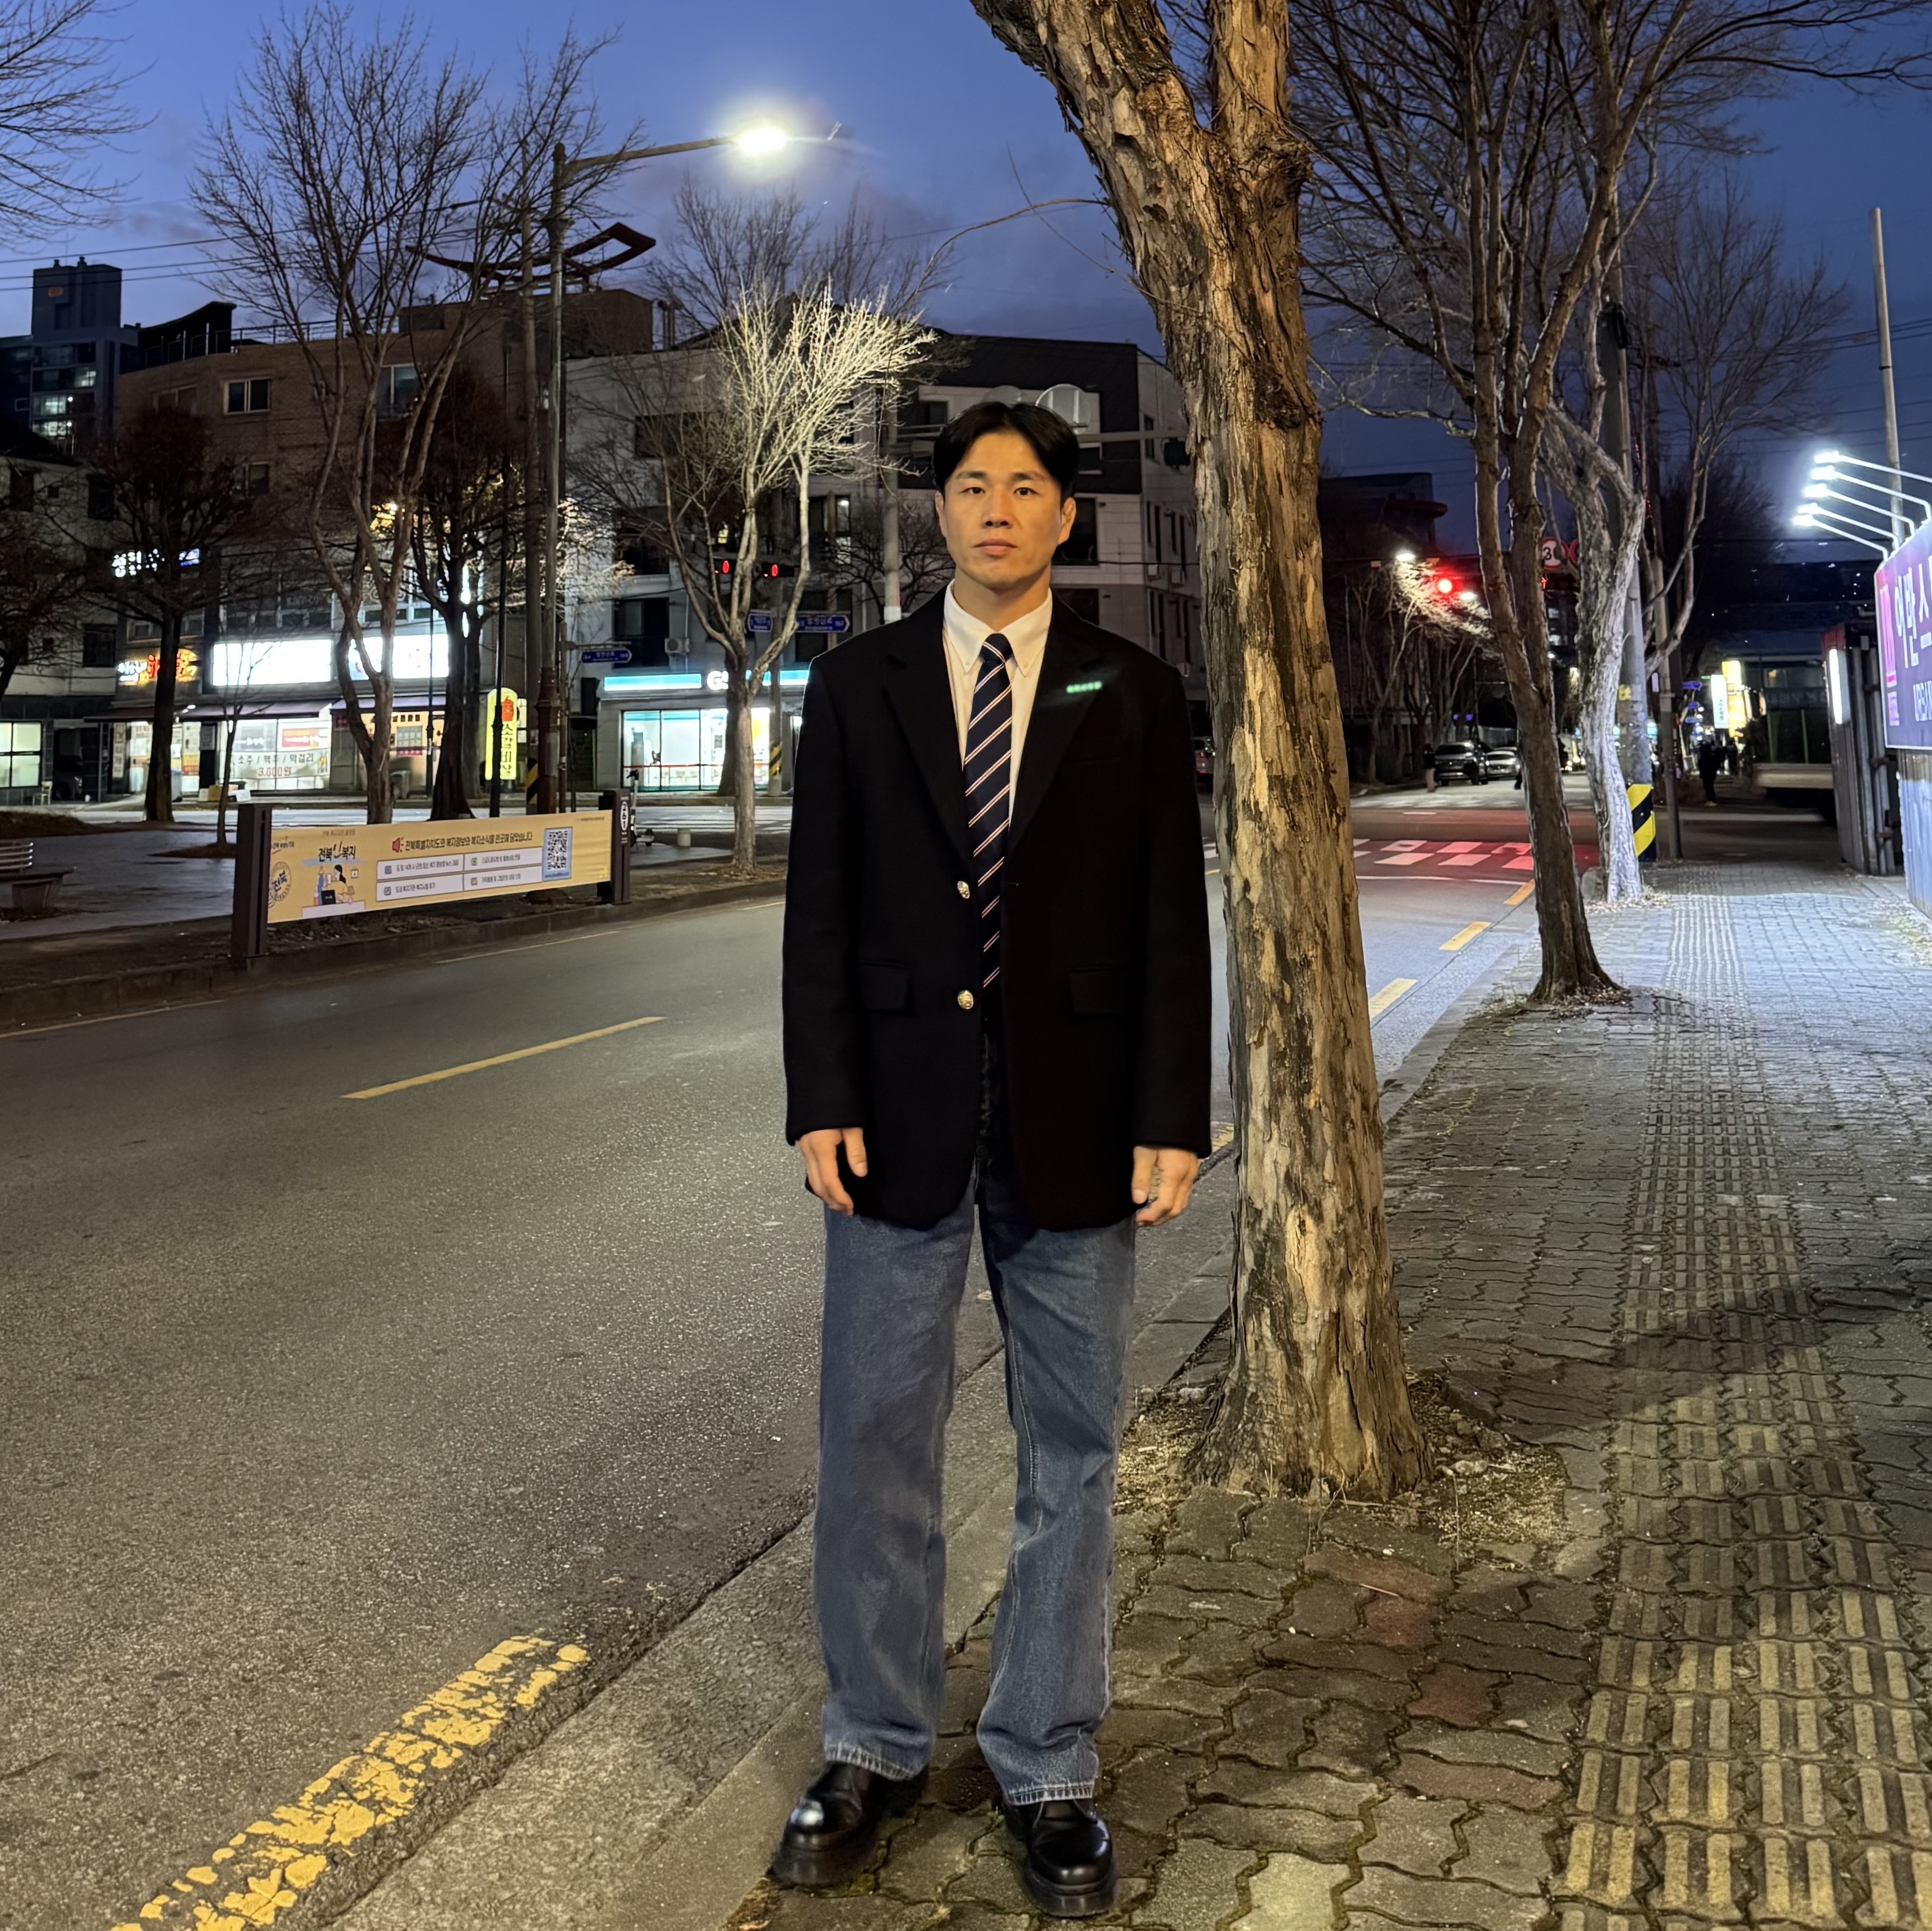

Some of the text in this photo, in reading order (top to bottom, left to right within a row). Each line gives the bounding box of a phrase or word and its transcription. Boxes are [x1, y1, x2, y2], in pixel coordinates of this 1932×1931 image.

[1895, 554, 1932, 669] 어반스
[238, 755, 253, 764] 소주
[264, 755, 277, 764] 맥주
[290, 753, 314, 764] 막걸리
[342, 845, 356, 860] 복지
